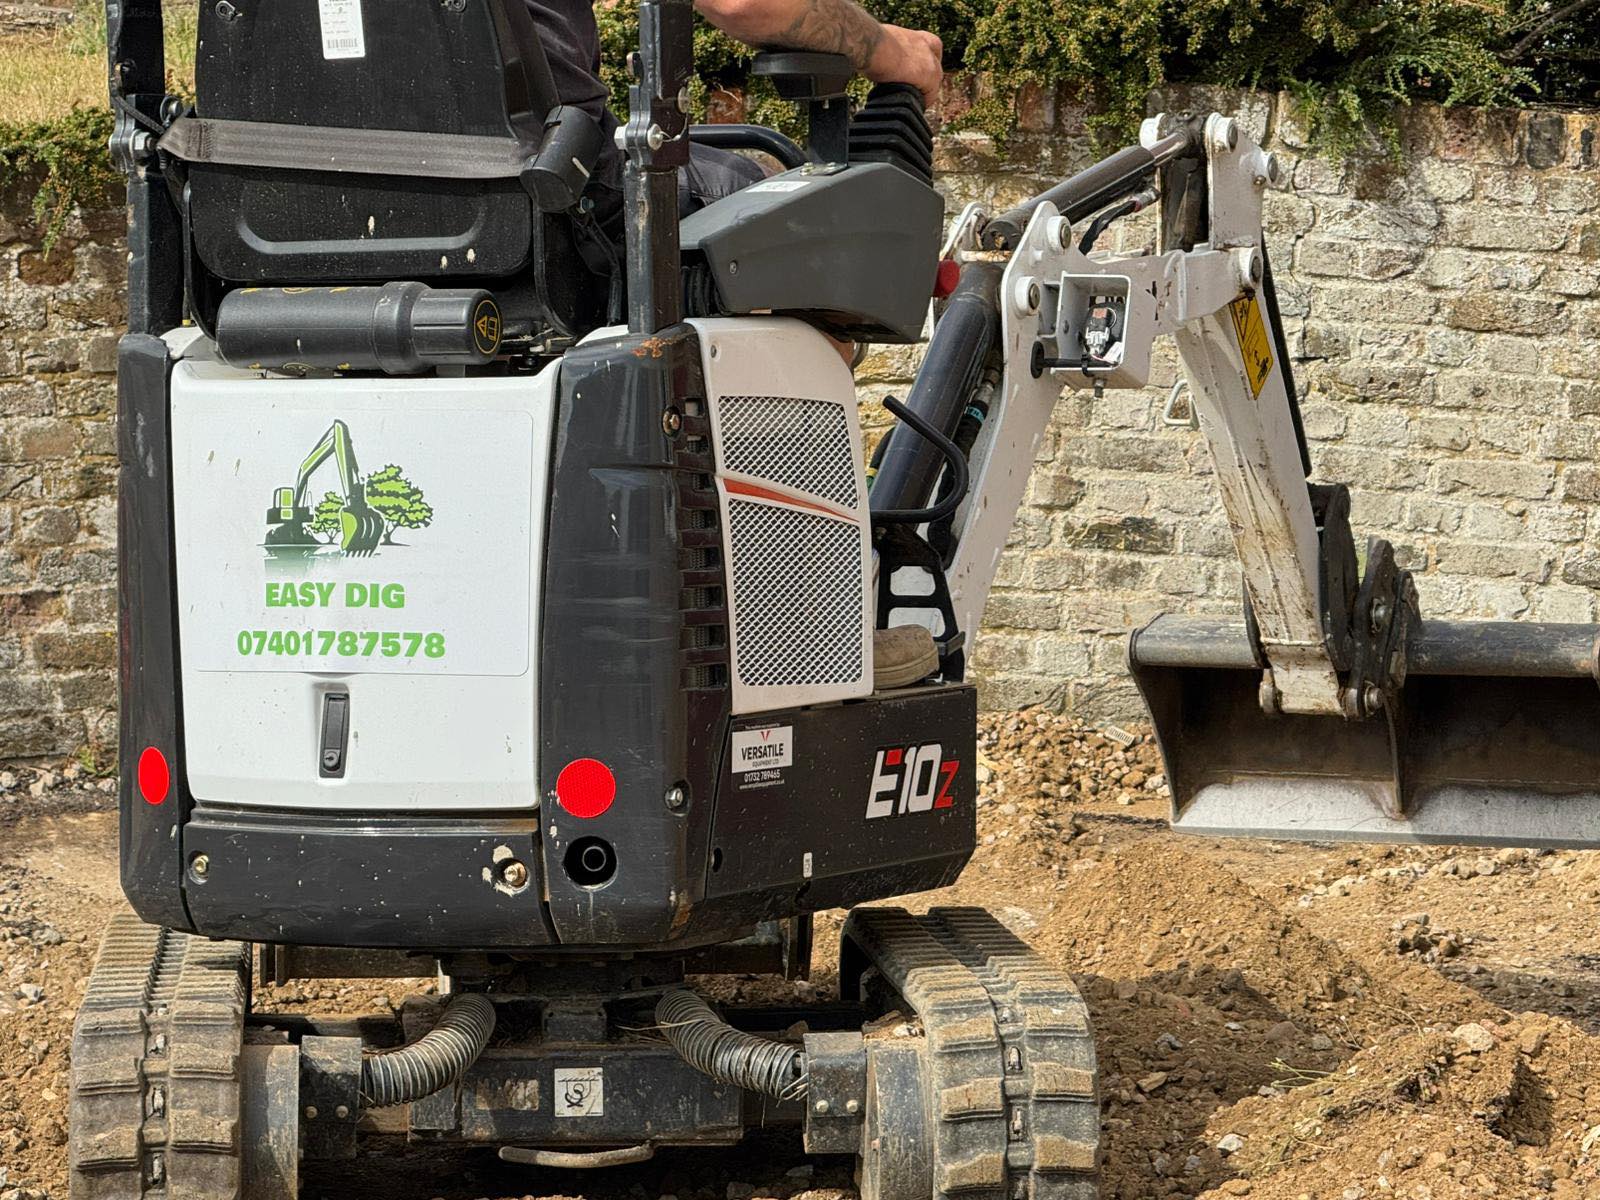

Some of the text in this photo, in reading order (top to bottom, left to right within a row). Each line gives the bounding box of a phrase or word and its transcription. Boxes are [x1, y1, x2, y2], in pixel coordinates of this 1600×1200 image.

[265, 582, 405, 608] EASY DIG
[237, 630, 445, 658] 07401787578
[741, 743, 784, 760] VERSATILE
[744, 771, 760, 783] 01732
